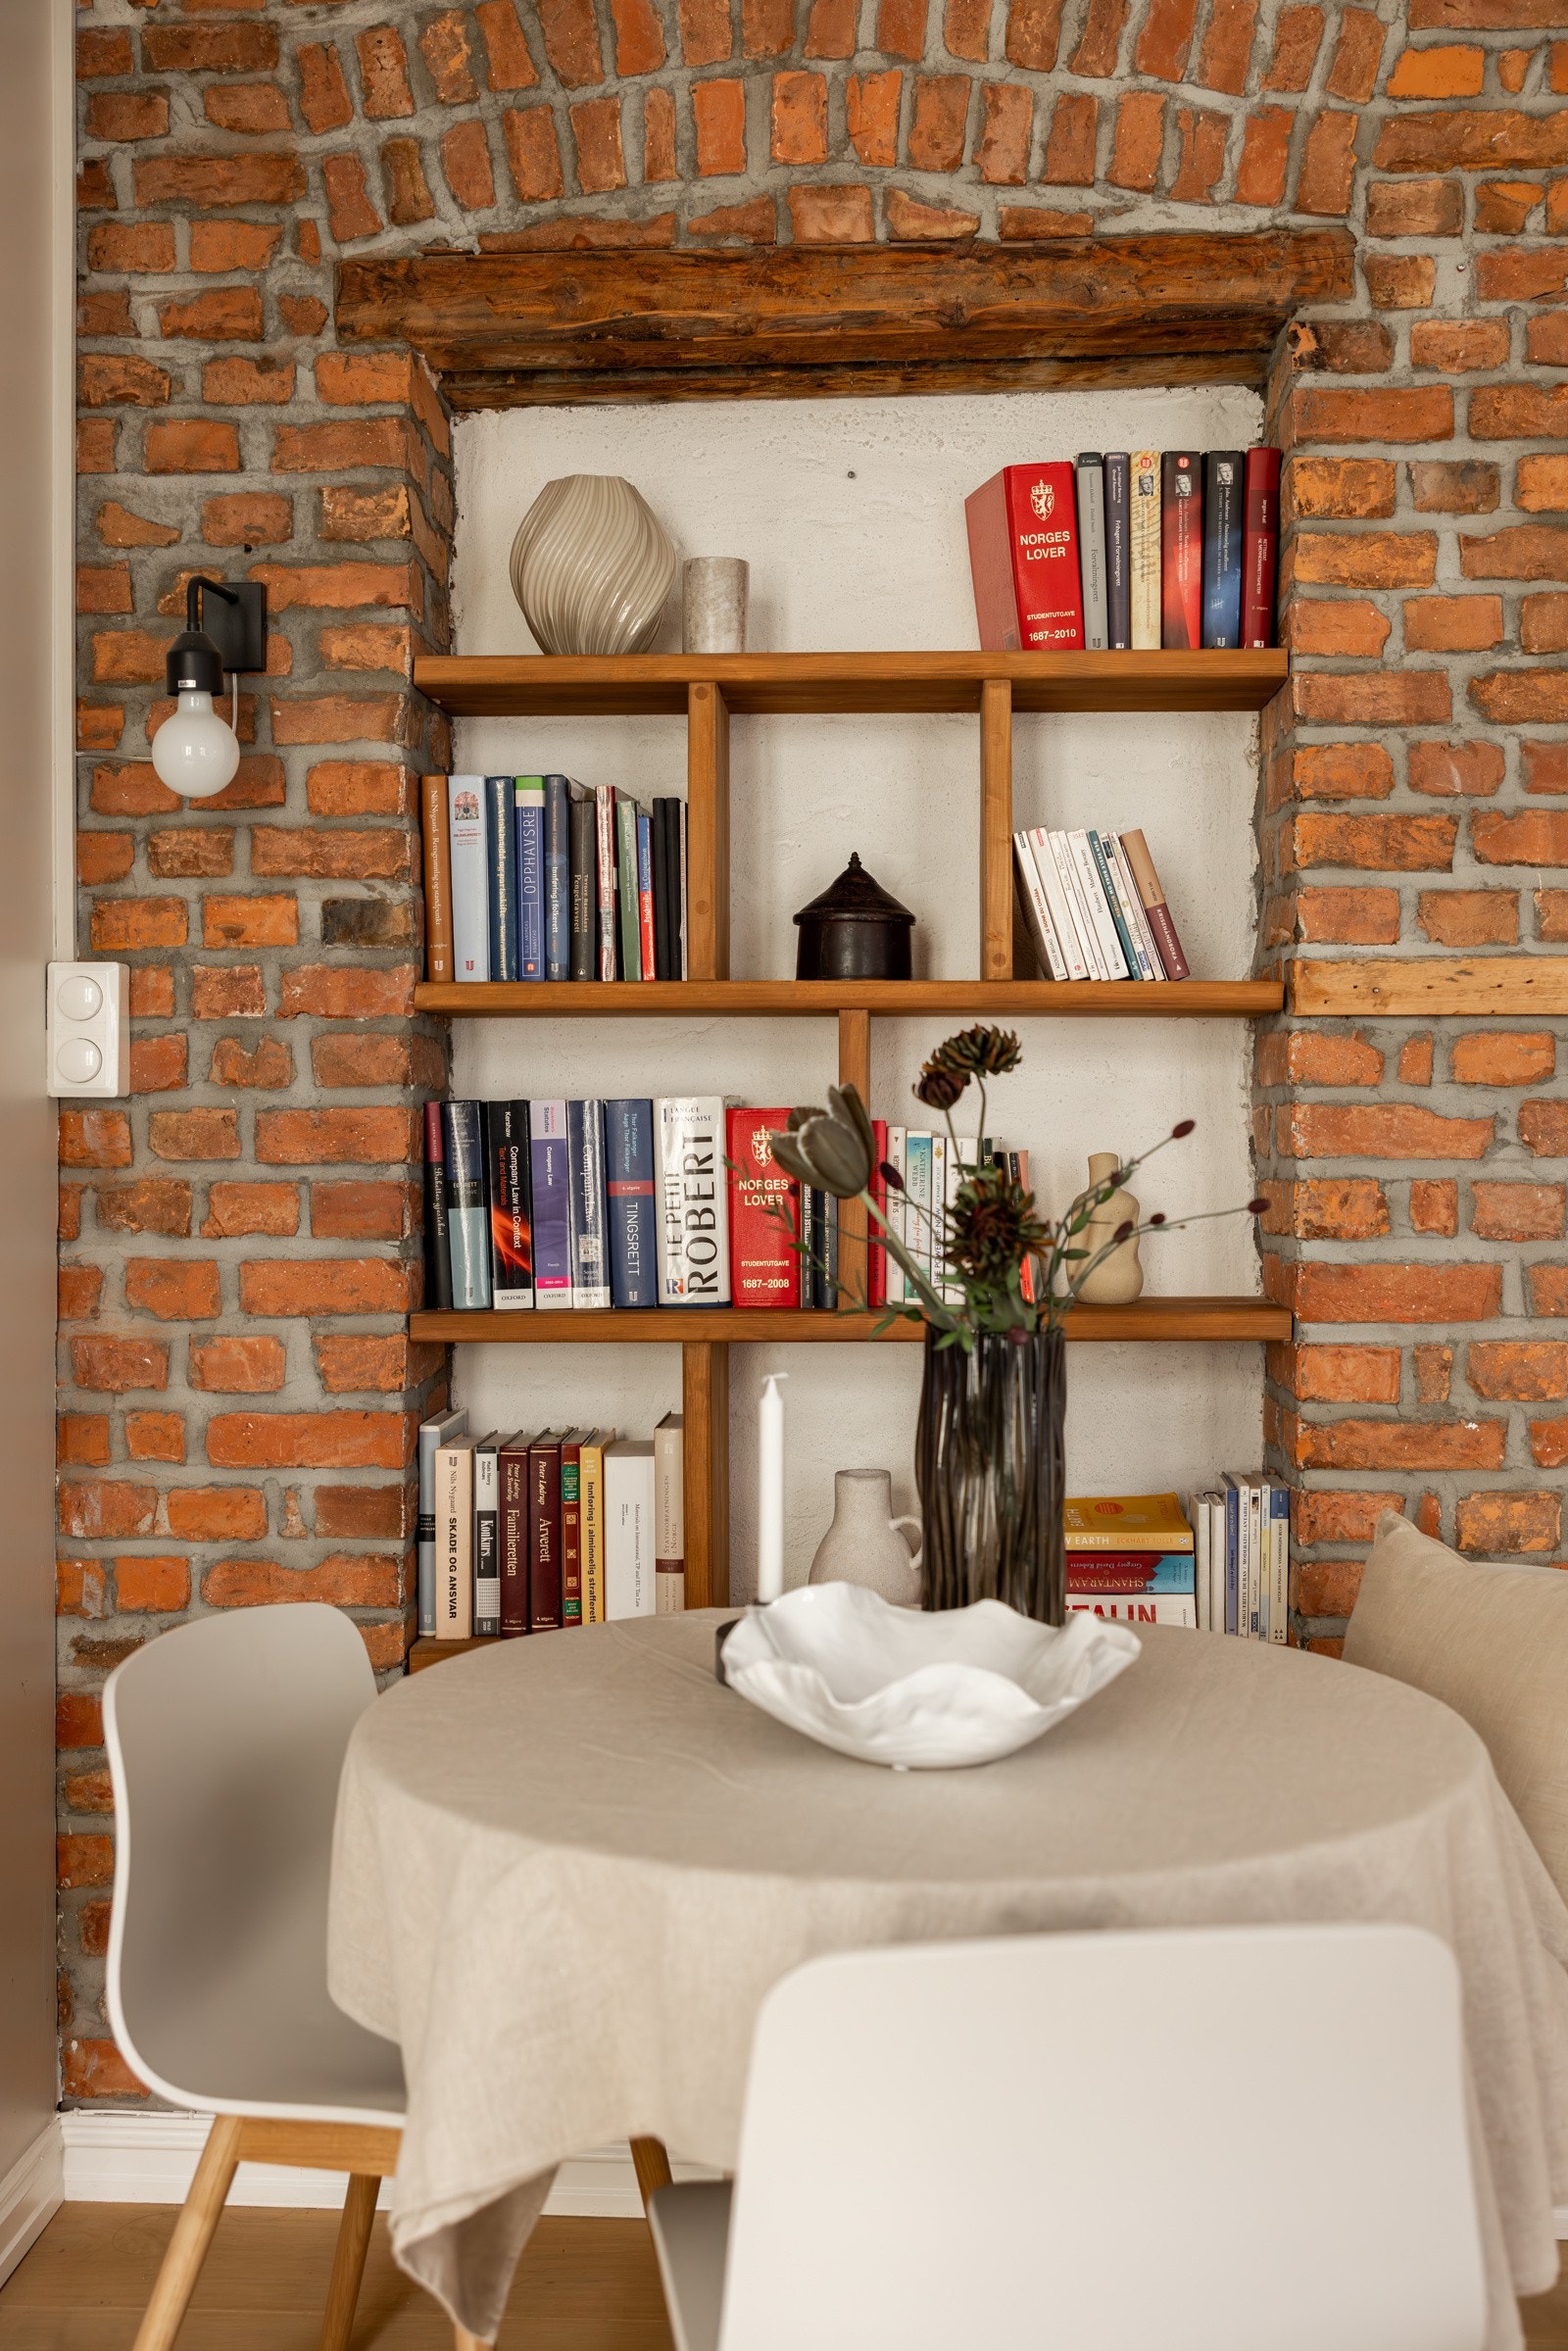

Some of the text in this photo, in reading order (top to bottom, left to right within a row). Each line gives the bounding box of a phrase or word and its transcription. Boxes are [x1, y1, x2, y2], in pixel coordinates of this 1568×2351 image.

[1020, 531, 1070, 546] NORGES
[1026, 547, 1066, 561] LOVER
[1091, 549, 1100, 602] Forvaltningsrett
[1026, 611, 1075, 621] STUDENTUTGAVE
[431, 838, 440, 881] Rettsgrunnlag
[523, 807, 536, 894] OPPHAVSRE
[1078, 848, 1103, 913] Flaubert Madame Bovary
[433, 890, 442, 925] standpunkt
[1155, 907, 1179, 960] KRISEHÅNDBOKA
[510, 1147, 518, 1186] Company
[581, 1145, 595, 1223] Company Law
[738, 1179, 789, 1191] NORGES
[432, 1202, 444, 1237] gjestebud
[513, 1205, 520, 1214] in
[664, 1170, 682, 1256] LE PETIT
[682, 1134, 718, 1295] ROBERT
[744, 1195, 784, 1206] LOVER
[513, 1216, 521, 1249] Context
[626, 1202, 640, 1275] TINGSRETT
[448, 1486, 457, 1513] Nygaard
[537, 1480, 547, 1505] Lødrup
[586, 1482, 595, 1521] Innføring
[480, 1519, 494, 1556] Konkurs
[507, 1509, 520, 1576] Familieretten
[540, 1518, 552, 1562] Arverett
[587, 1529, 596, 1575] alminnelig
[449, 1557, 457, 1573] OG
[1068, 1578, 1145, 1588] SHANTARAM
